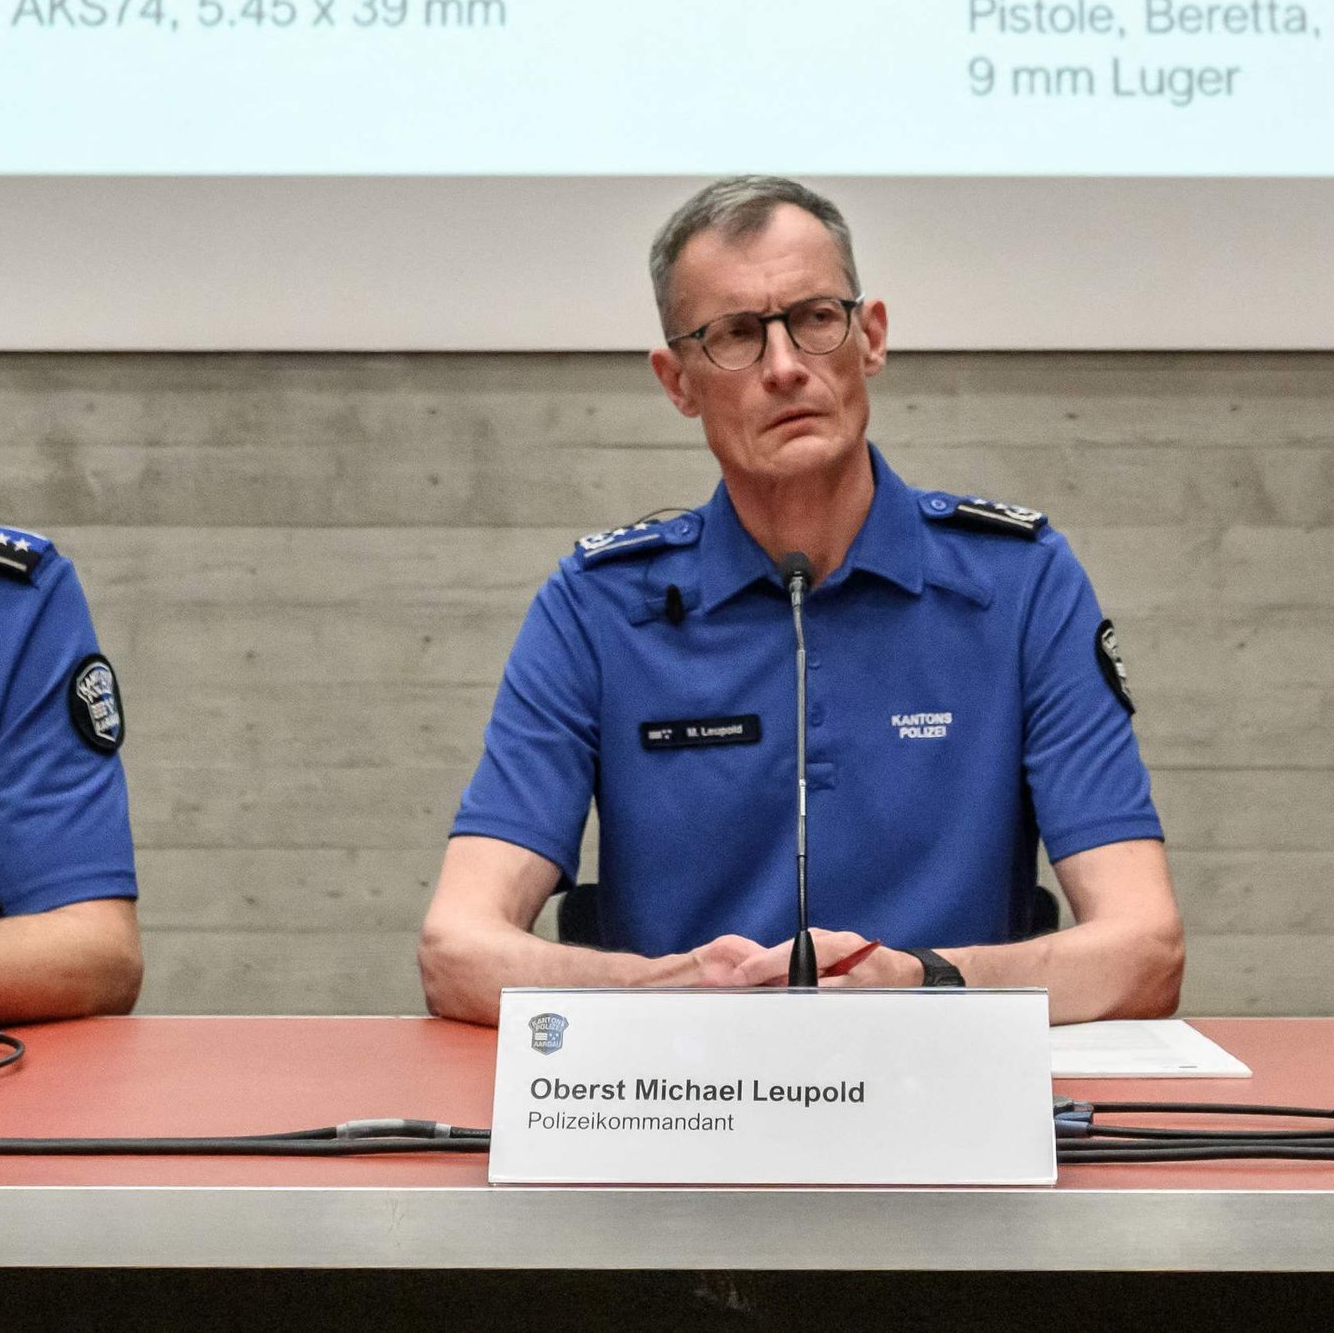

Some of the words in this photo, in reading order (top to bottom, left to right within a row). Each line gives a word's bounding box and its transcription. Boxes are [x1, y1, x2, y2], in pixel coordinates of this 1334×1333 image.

[968, 56, 995, 97] 9
[1012, 66, 1095, 97] mm
[1112, 57, 1240, 107] Luger
[891, 712, 952, 726] KANTONS
[899, 726, 947, 738] POLIZEI
[530, 1078, 625, 1101] Oberst
[635, 1078, 742, 1102] Michael
[753, 1079, 865, 1107] Leupold
[528, 1111, 734, 1131] Polizeikommandant
